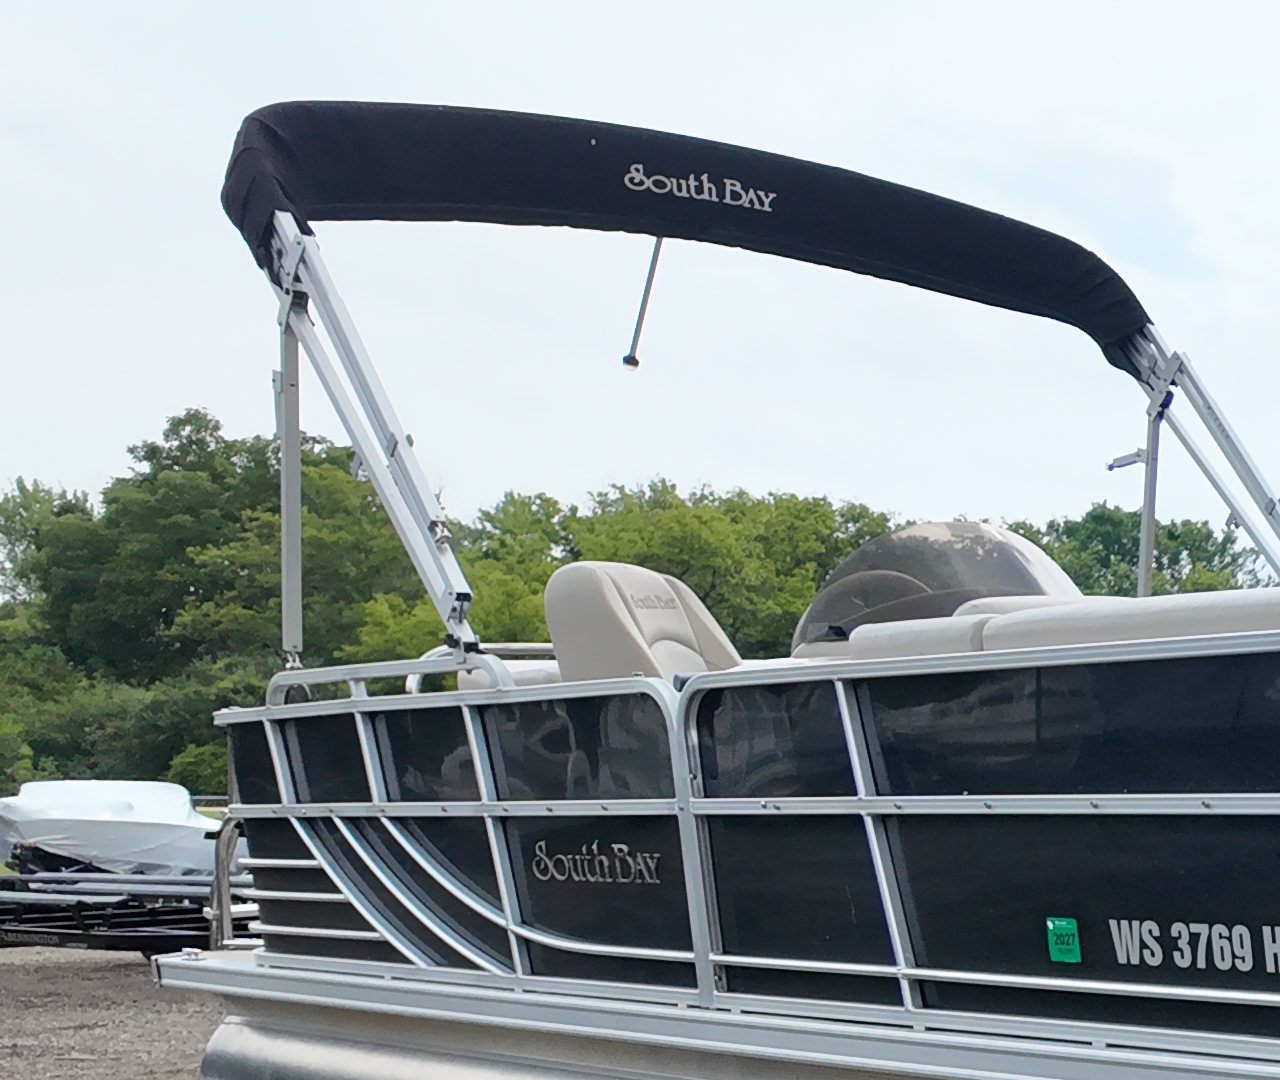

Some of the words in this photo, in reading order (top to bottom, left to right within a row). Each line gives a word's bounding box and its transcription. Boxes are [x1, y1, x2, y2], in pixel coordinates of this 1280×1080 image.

[623, 163, 720, 202] South
[722, 178, 778, 212] BAY
[532, 839, 614, 882] South
[610, 843, 662, 884] BAY
[1053, 932, 1076, 946] 2027
[1108, 918, 1164, 967] WS
[1170, 922, 1254, 972] 3769
